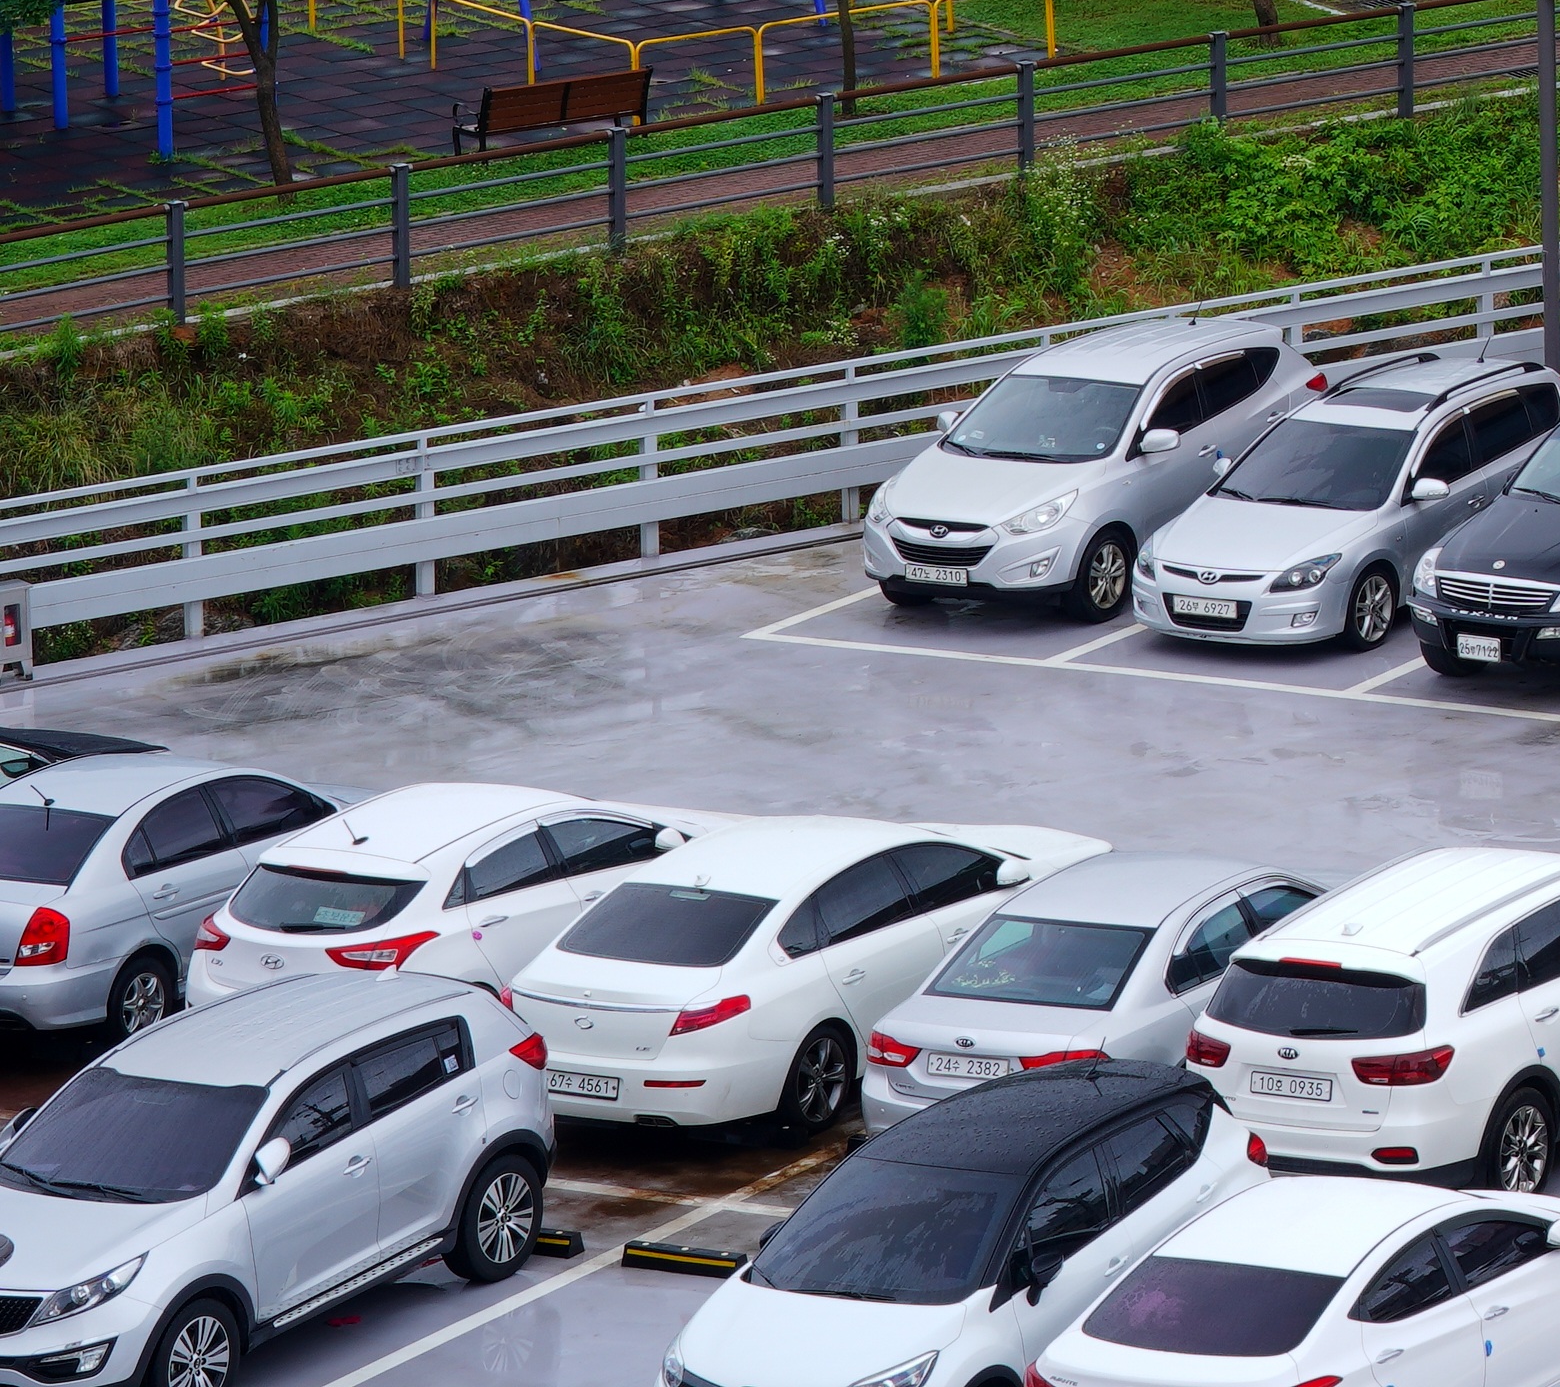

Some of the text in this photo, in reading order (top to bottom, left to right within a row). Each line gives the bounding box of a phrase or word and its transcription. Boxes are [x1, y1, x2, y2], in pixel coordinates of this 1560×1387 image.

[911, 567, 961, 582] 47노 2310
[1204, 602, 1230, 615] 6927
[1280, 1048, 1296, 1058] KIA
[935, 1057, 1000, 1077] 24수 2382
[550, 1074, 609, 1094] 67수 4561
[1259, 1076, 1323, 1097] 10호 0935
